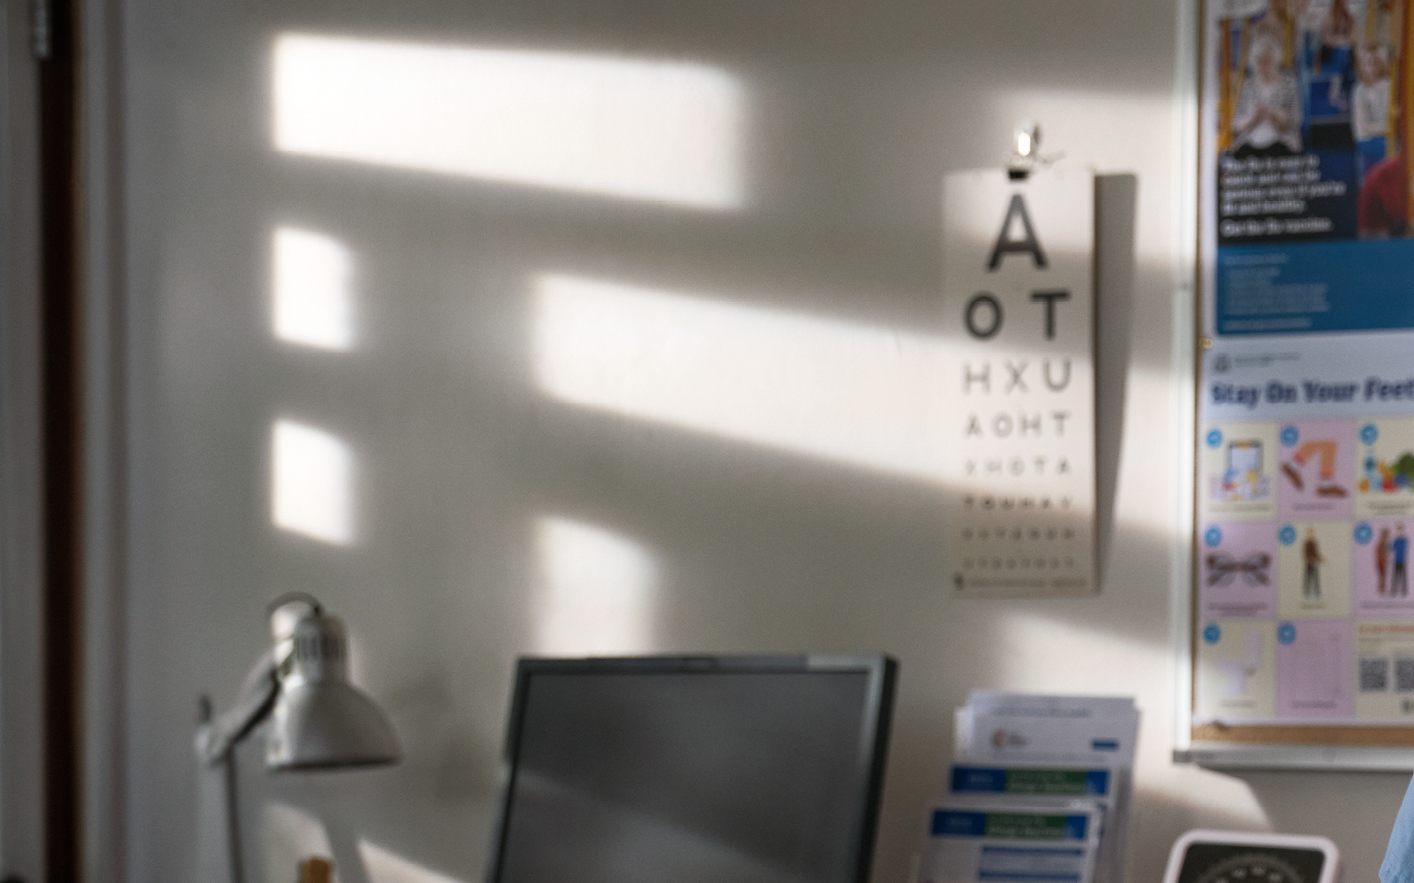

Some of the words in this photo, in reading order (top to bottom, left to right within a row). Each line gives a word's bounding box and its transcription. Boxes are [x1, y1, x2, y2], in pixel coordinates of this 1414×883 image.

[988, 194, 1048, 271] A
[1211, 383, 1260, 410] Stay
[1265, 380, 1296, 403] On
[1302, 378, 1359, 402] Your
